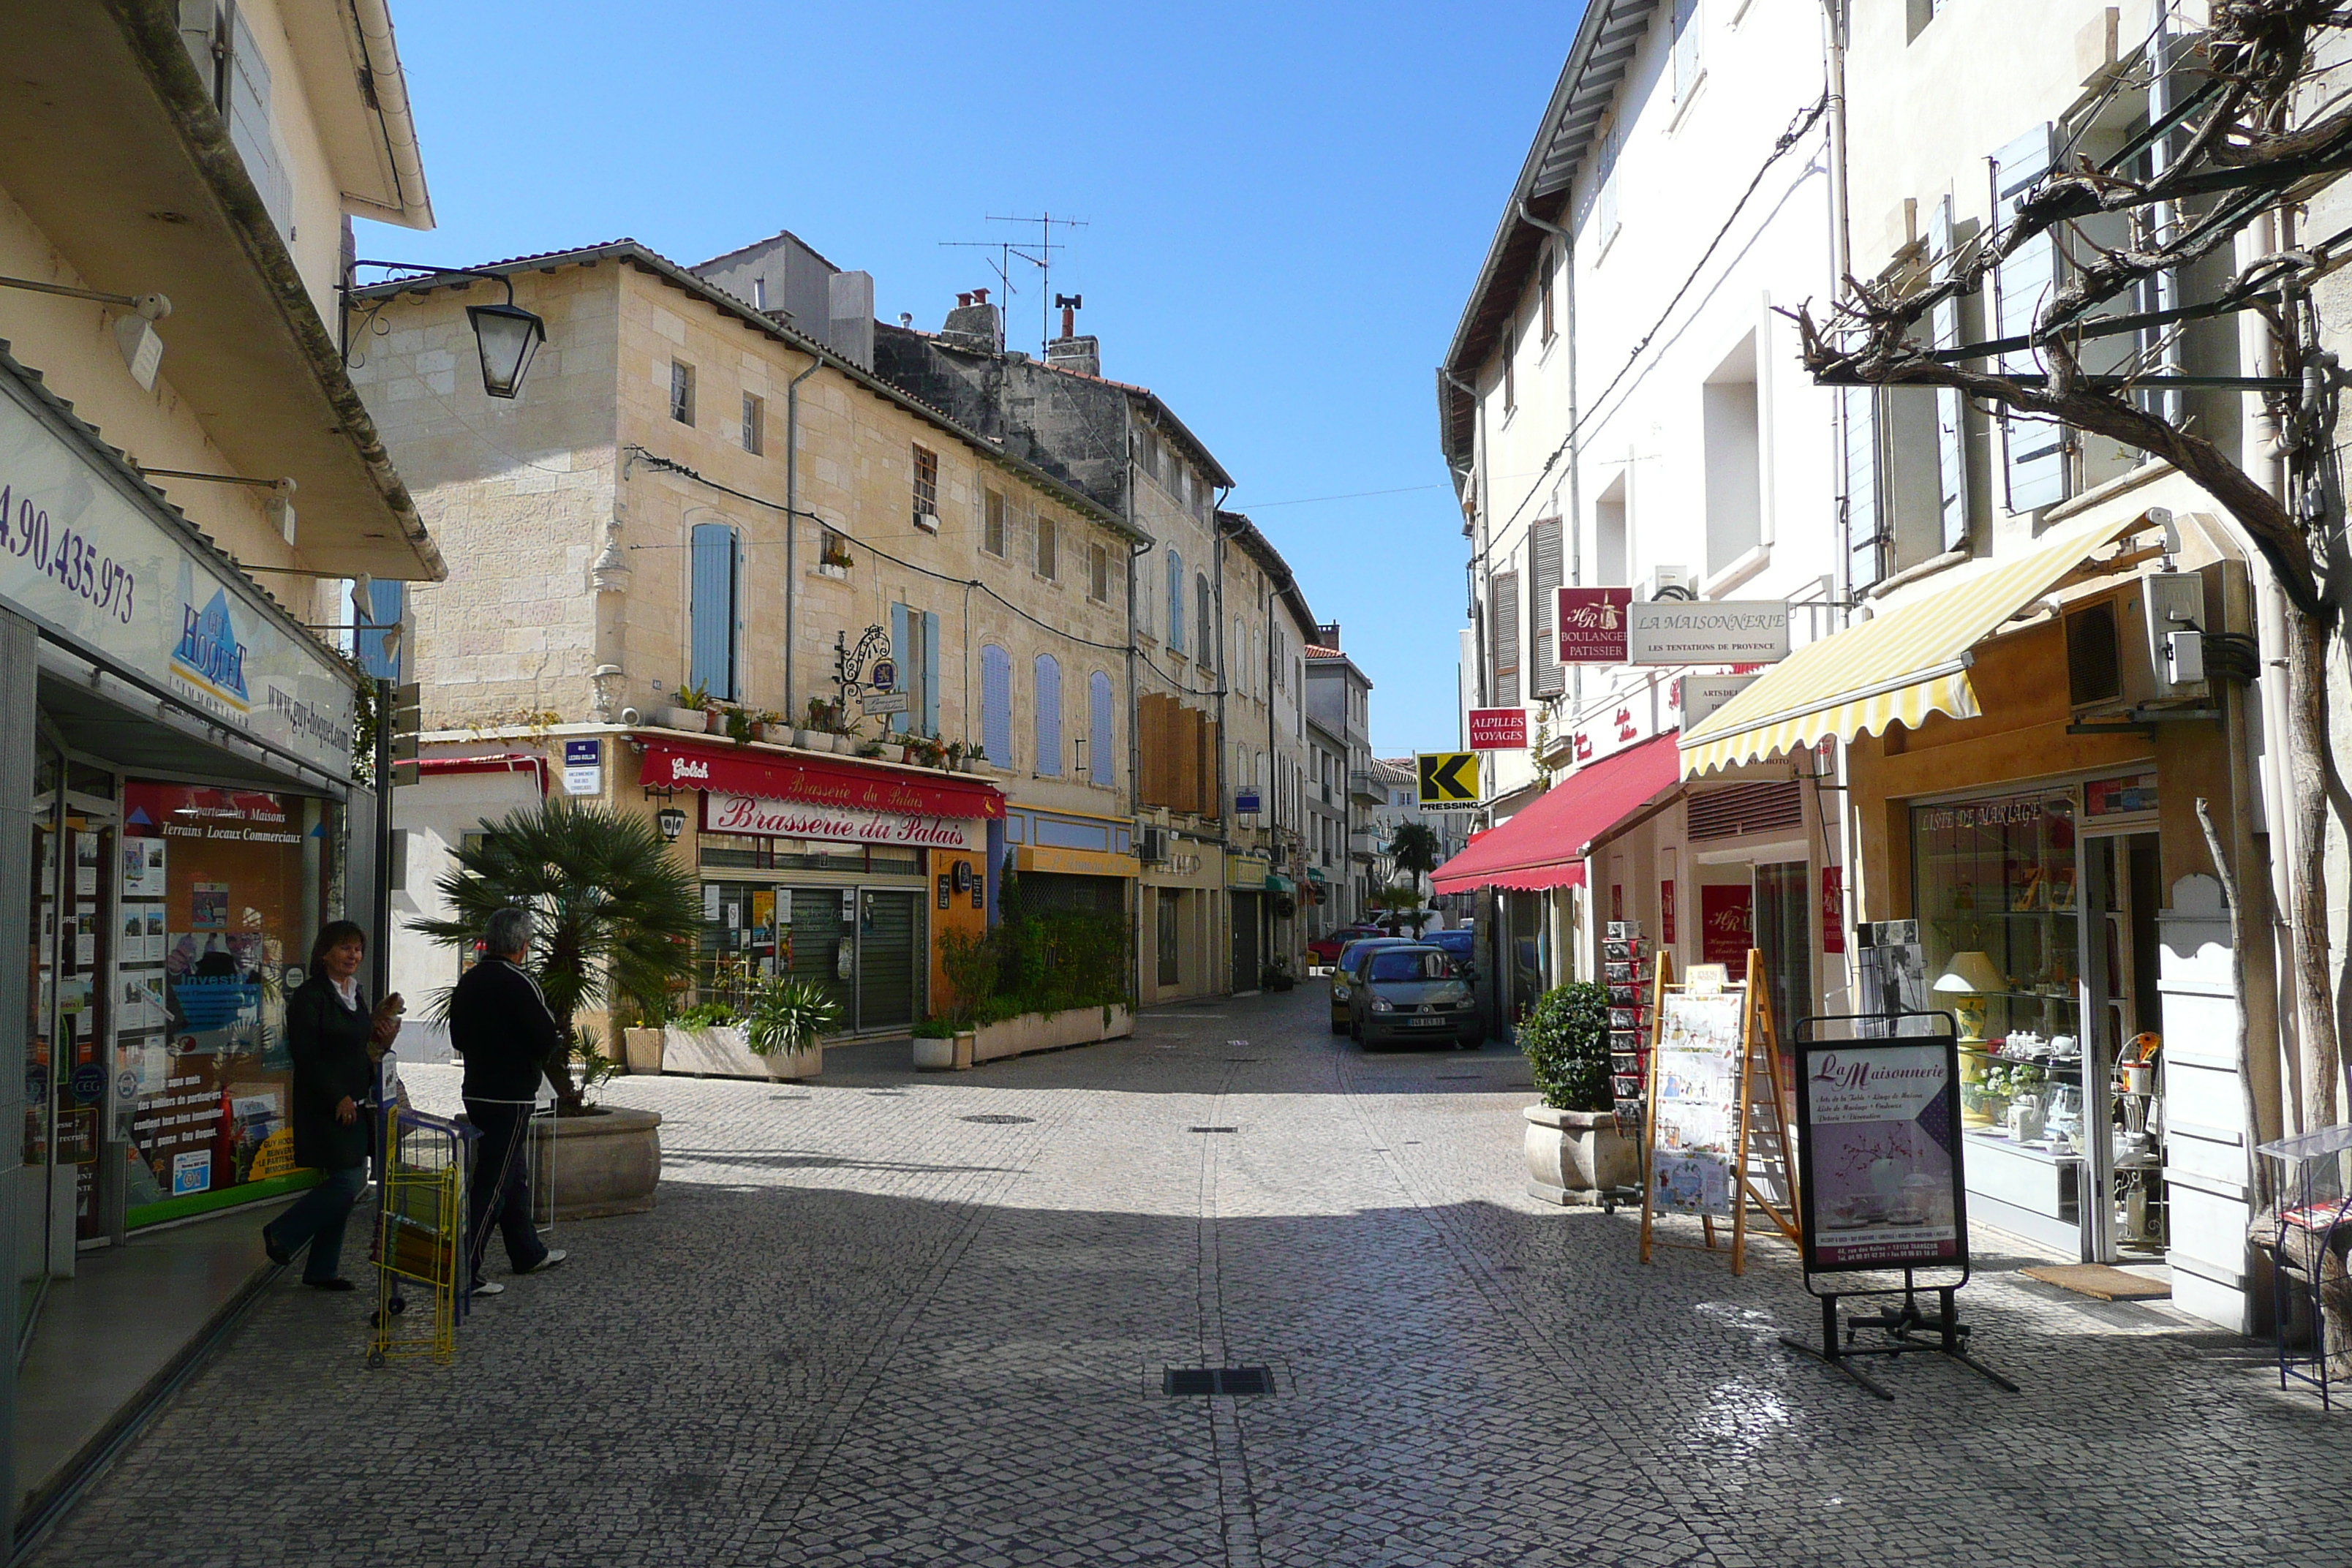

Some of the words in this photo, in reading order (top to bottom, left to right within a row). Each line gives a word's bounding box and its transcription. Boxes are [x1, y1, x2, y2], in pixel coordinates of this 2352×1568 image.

[208, 609, 227, 641] GUY
[1637, 615, 1659, 630] LA
[1664, 614, 1786, 631] MAISONNERIE
[181, 602, 247, 693] HOQUET
[1569, 646, 1624, 656] PATISSIER
[1666, 644, 1715, 652] TENTATIONS
[1732, 643, 1776, 651] PROVENCE
[268, 684, 349, 753] www.guy-hoquet.com
[1471, 717, 1524, 728] ALPILLES
[1474, 731, 1523, 742] VOYAGES
[671, 757, 709, 780] Grolsch
[788, 771, 851, 799] Brasserie
[863, 783, 878, 802] du
[887, 786, 923, 808] Palais
[250, 807, 287, 823] Maisons
[1420, 802, 1479, 811] PRESSING
[1922, 811, 1953, 832] LISTE
[1957, 809, 1975, 827] DE
[1978, 802, 2041, 827] MARIAGE
[717, 796, 854, 836] Brasserie
[859, 813, 892, 839] du
[897, 815, 965, 845] Palais
[162, 821, 203, 838] Terrains
[207, 825, 241, 840] Locaux
[243, 827, 302, 844] Commerciaux
[1810, 1054, 1844, 1082] La
[1833, 1062, 1945, 1090] Maisonnerie
